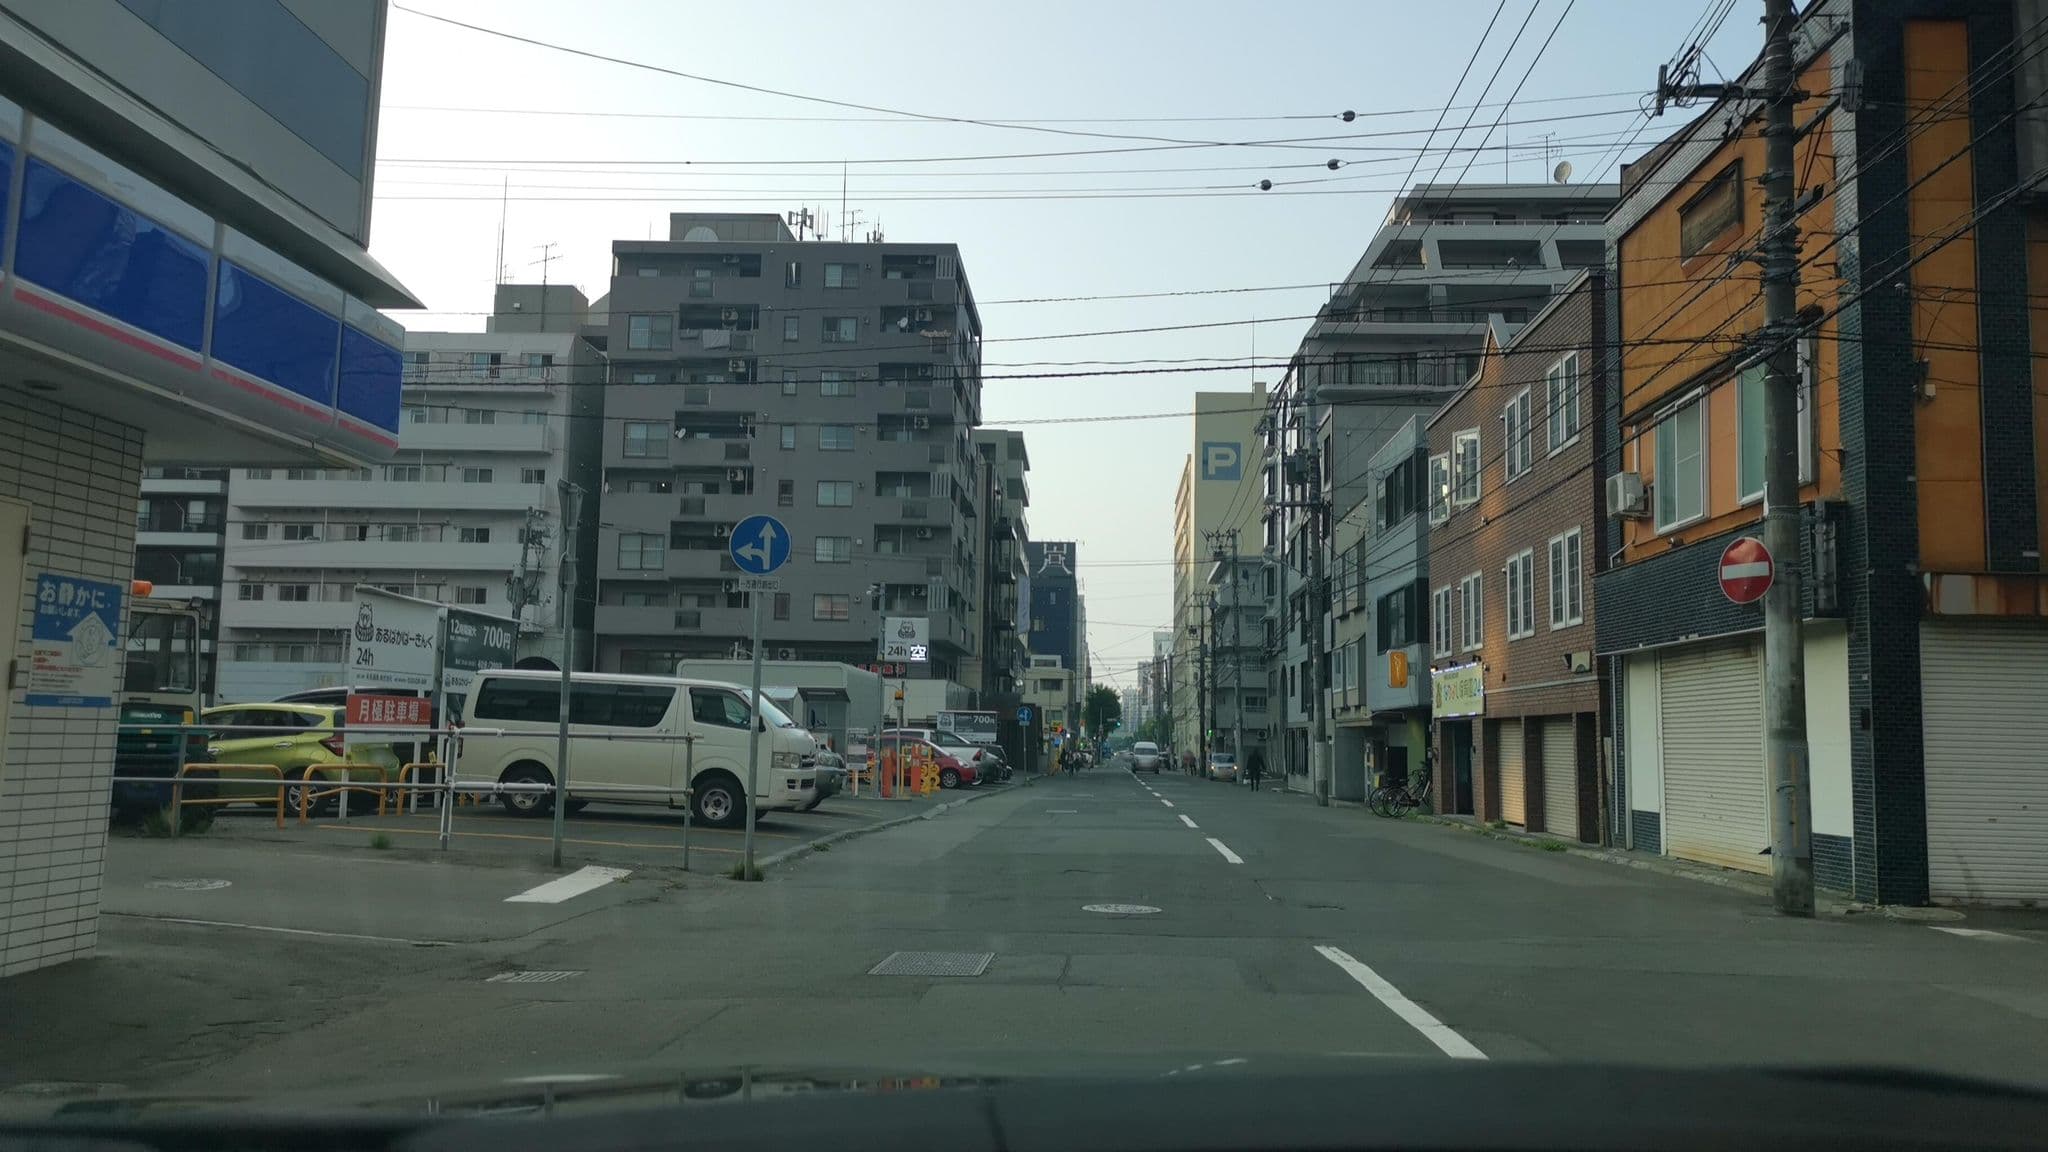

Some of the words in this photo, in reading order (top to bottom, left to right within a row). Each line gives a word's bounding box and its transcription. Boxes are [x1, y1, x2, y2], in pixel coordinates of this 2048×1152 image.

[1207, 446, 1237, 475] P
[483, 625, 511, 650] 700円
[356, 647, 374, 666] 24h
[887, 645, 907, 656] 24h
[910, 644, 927, 661] 空
[358, 699, 420, 722] 月極駐車場
